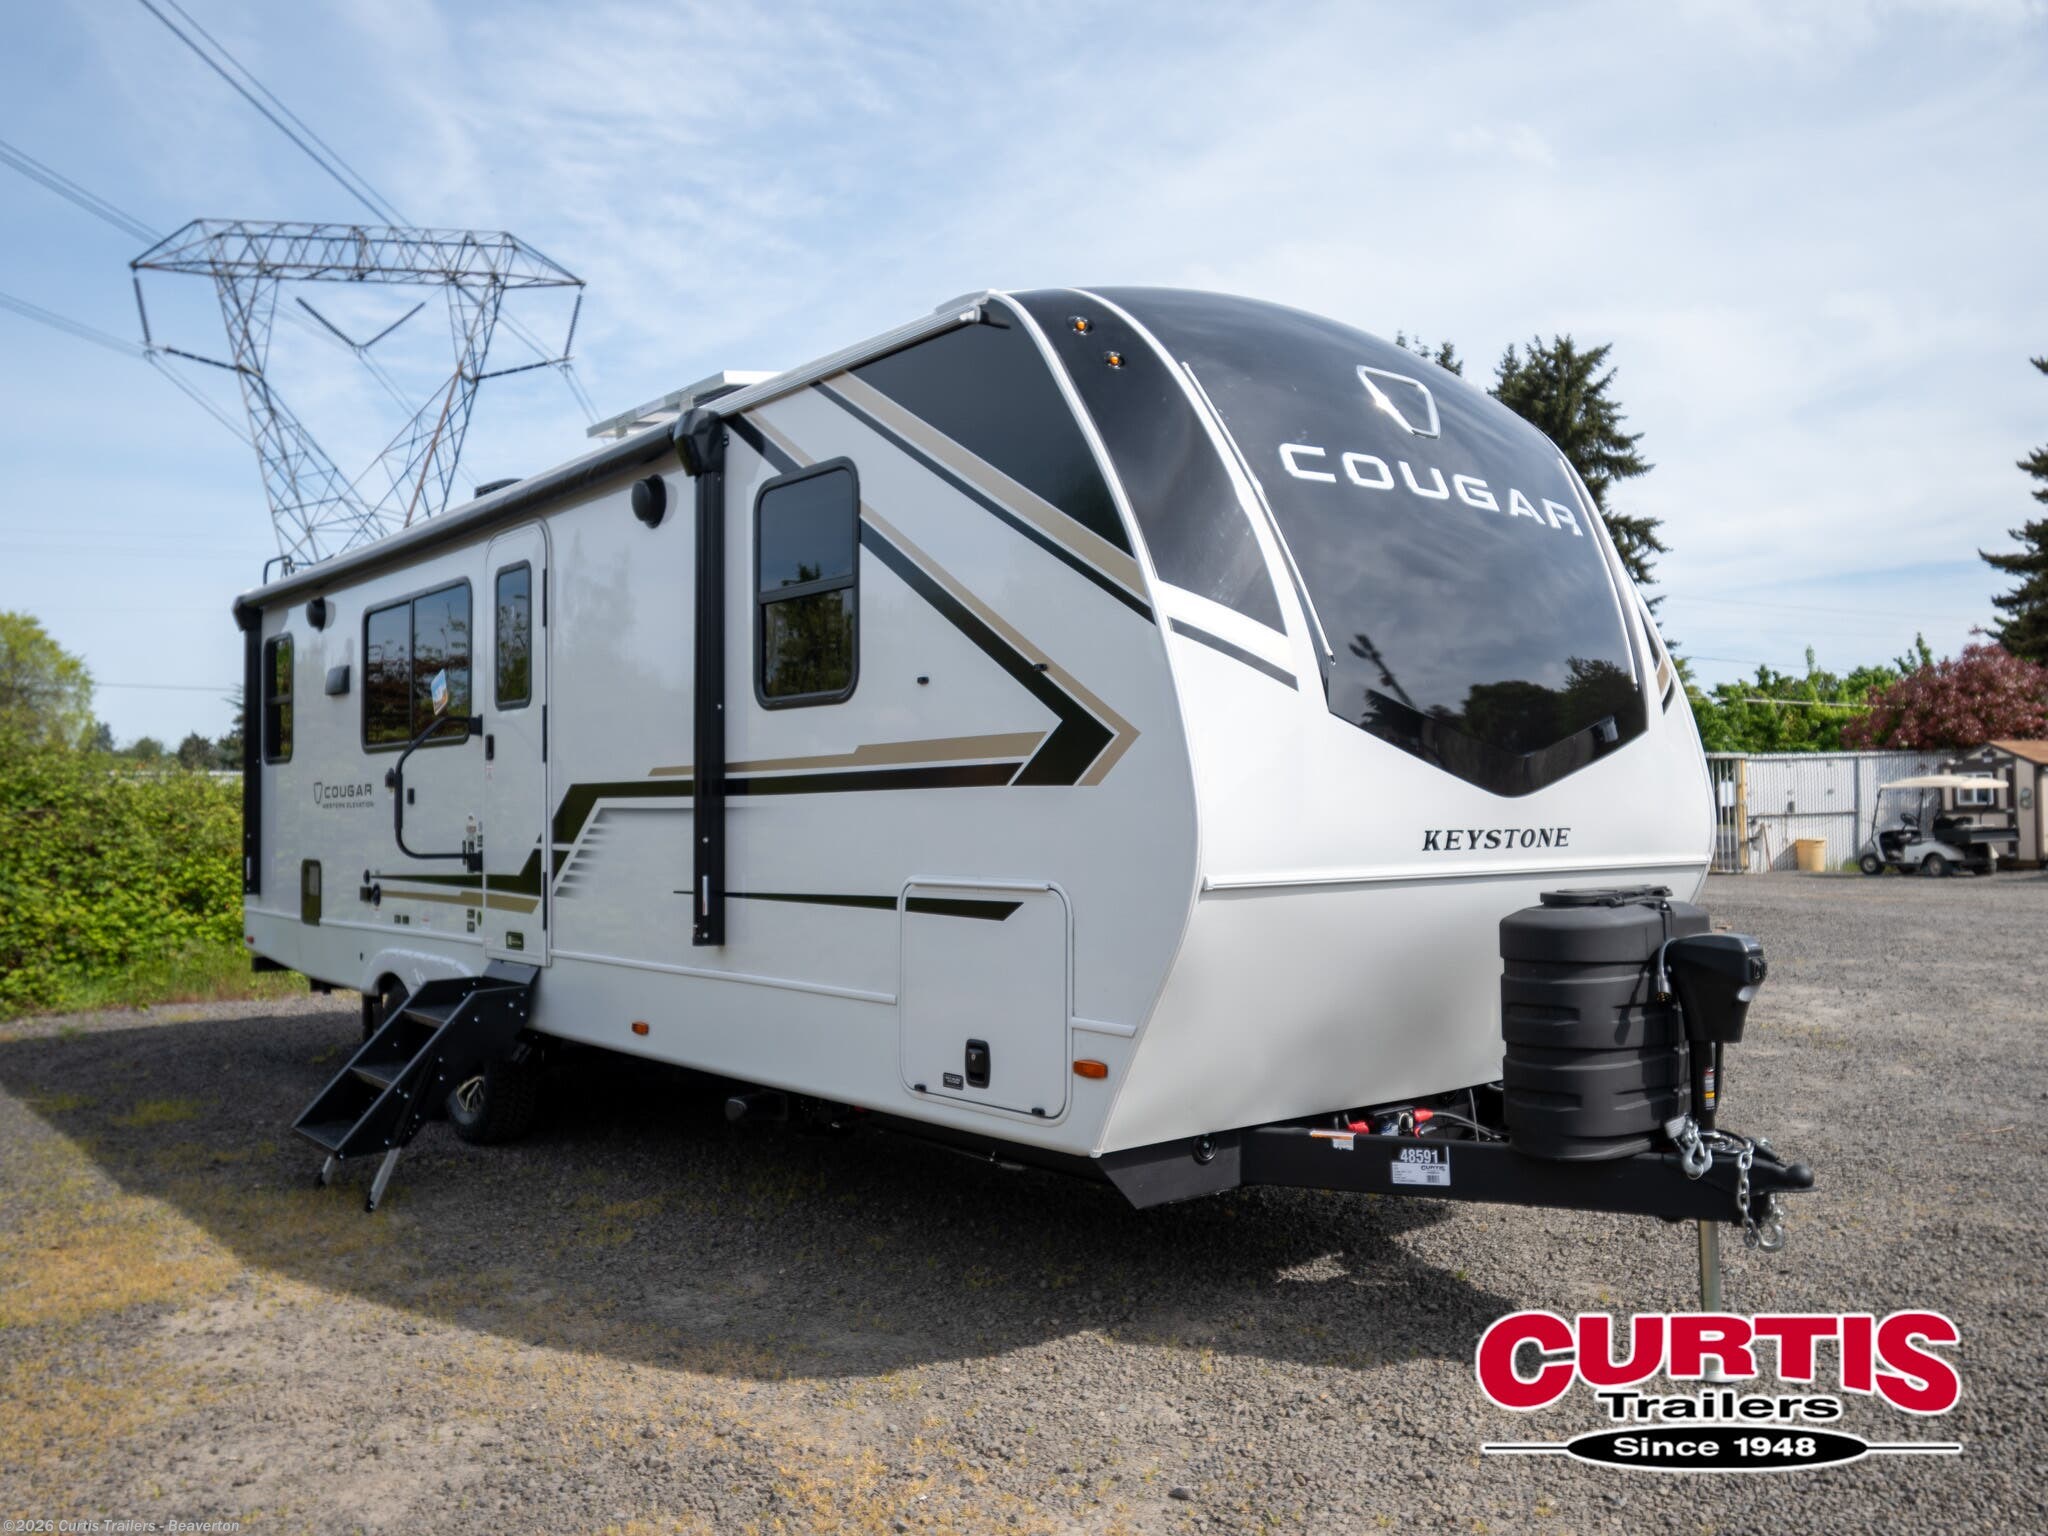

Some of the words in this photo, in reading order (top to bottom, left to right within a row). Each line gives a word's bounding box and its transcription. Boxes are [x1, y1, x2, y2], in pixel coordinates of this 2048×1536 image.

[1279, 443, 1583, 536] COUGAR
[324, 784, 372, 799] COUGAR
[1422, 827, 1571, 851] KEYSTONE
[1400, 1149, 1438, 1164] 48591
